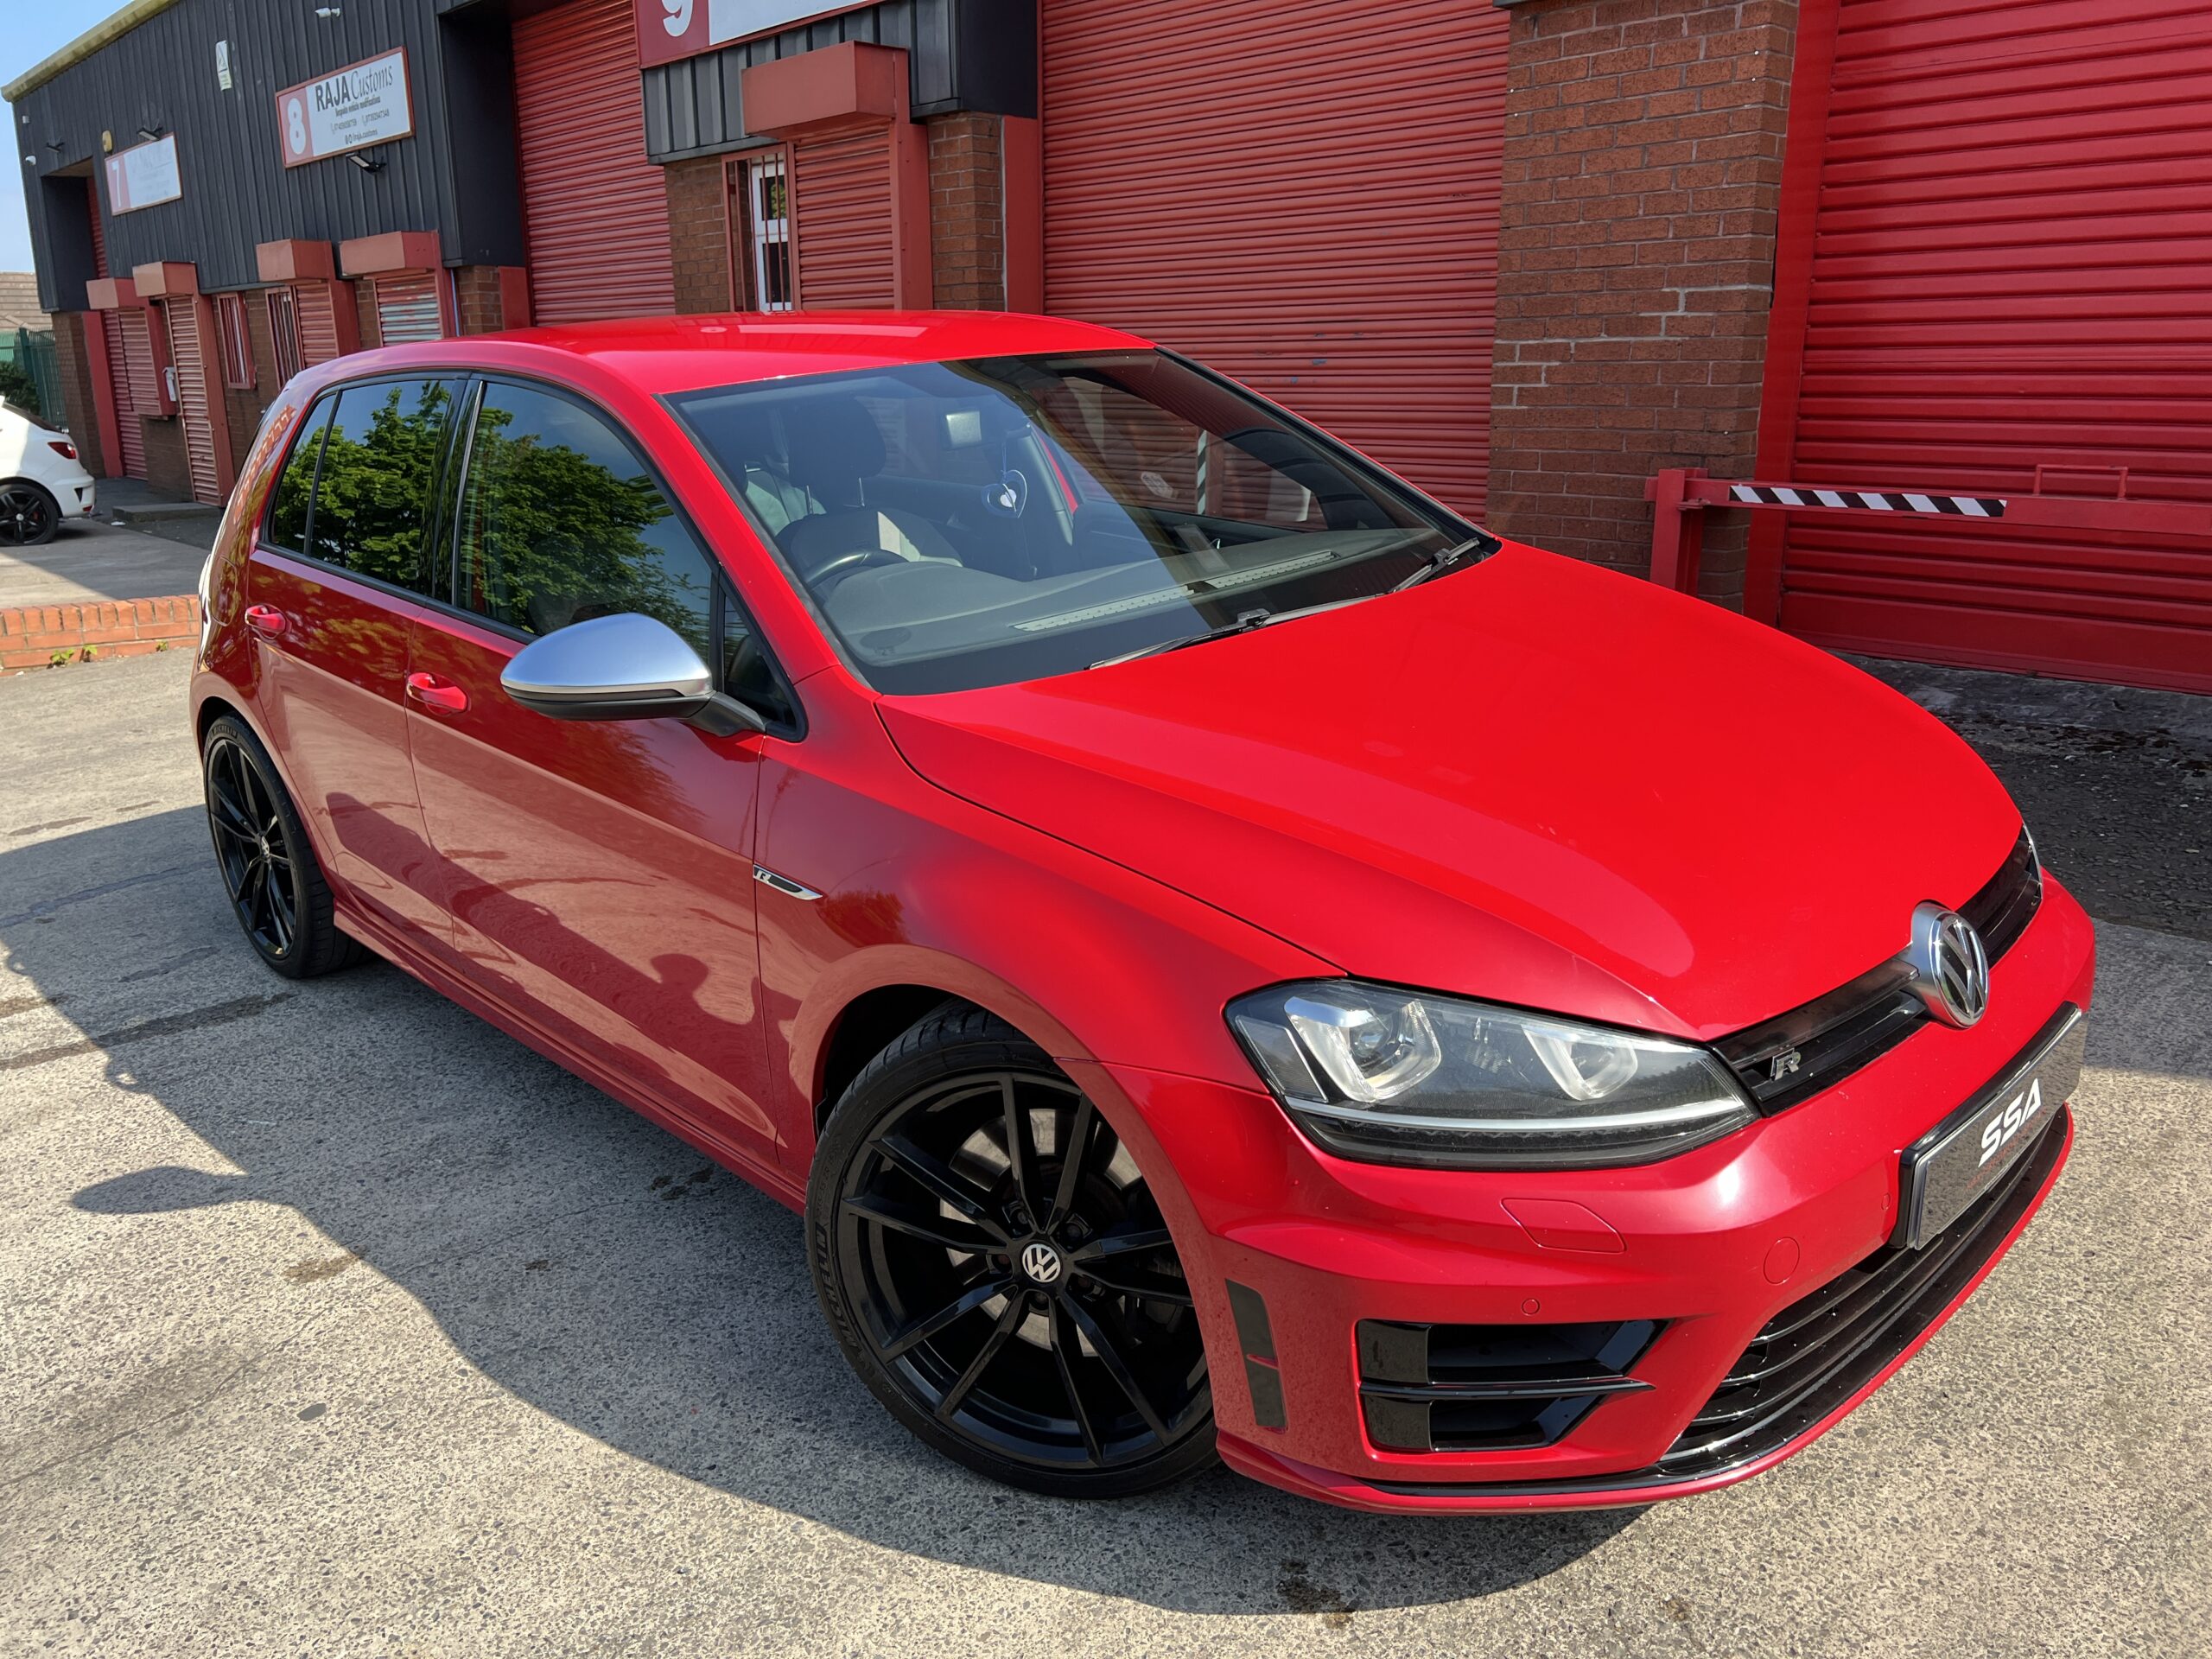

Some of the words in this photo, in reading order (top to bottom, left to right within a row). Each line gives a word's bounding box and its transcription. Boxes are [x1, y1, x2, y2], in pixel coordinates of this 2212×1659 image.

[315, 75, 351, 112] RAJA
[351, 65, 393, 100] Customs
[287, 98, 306, 155] 8
[111, 160, 121, 208] 7
[1772, 1049, 1802, 1081] R
[1978, 1077, 2041, 1168] SSA
[815, 1228, 858, 1350] MICHELIN
